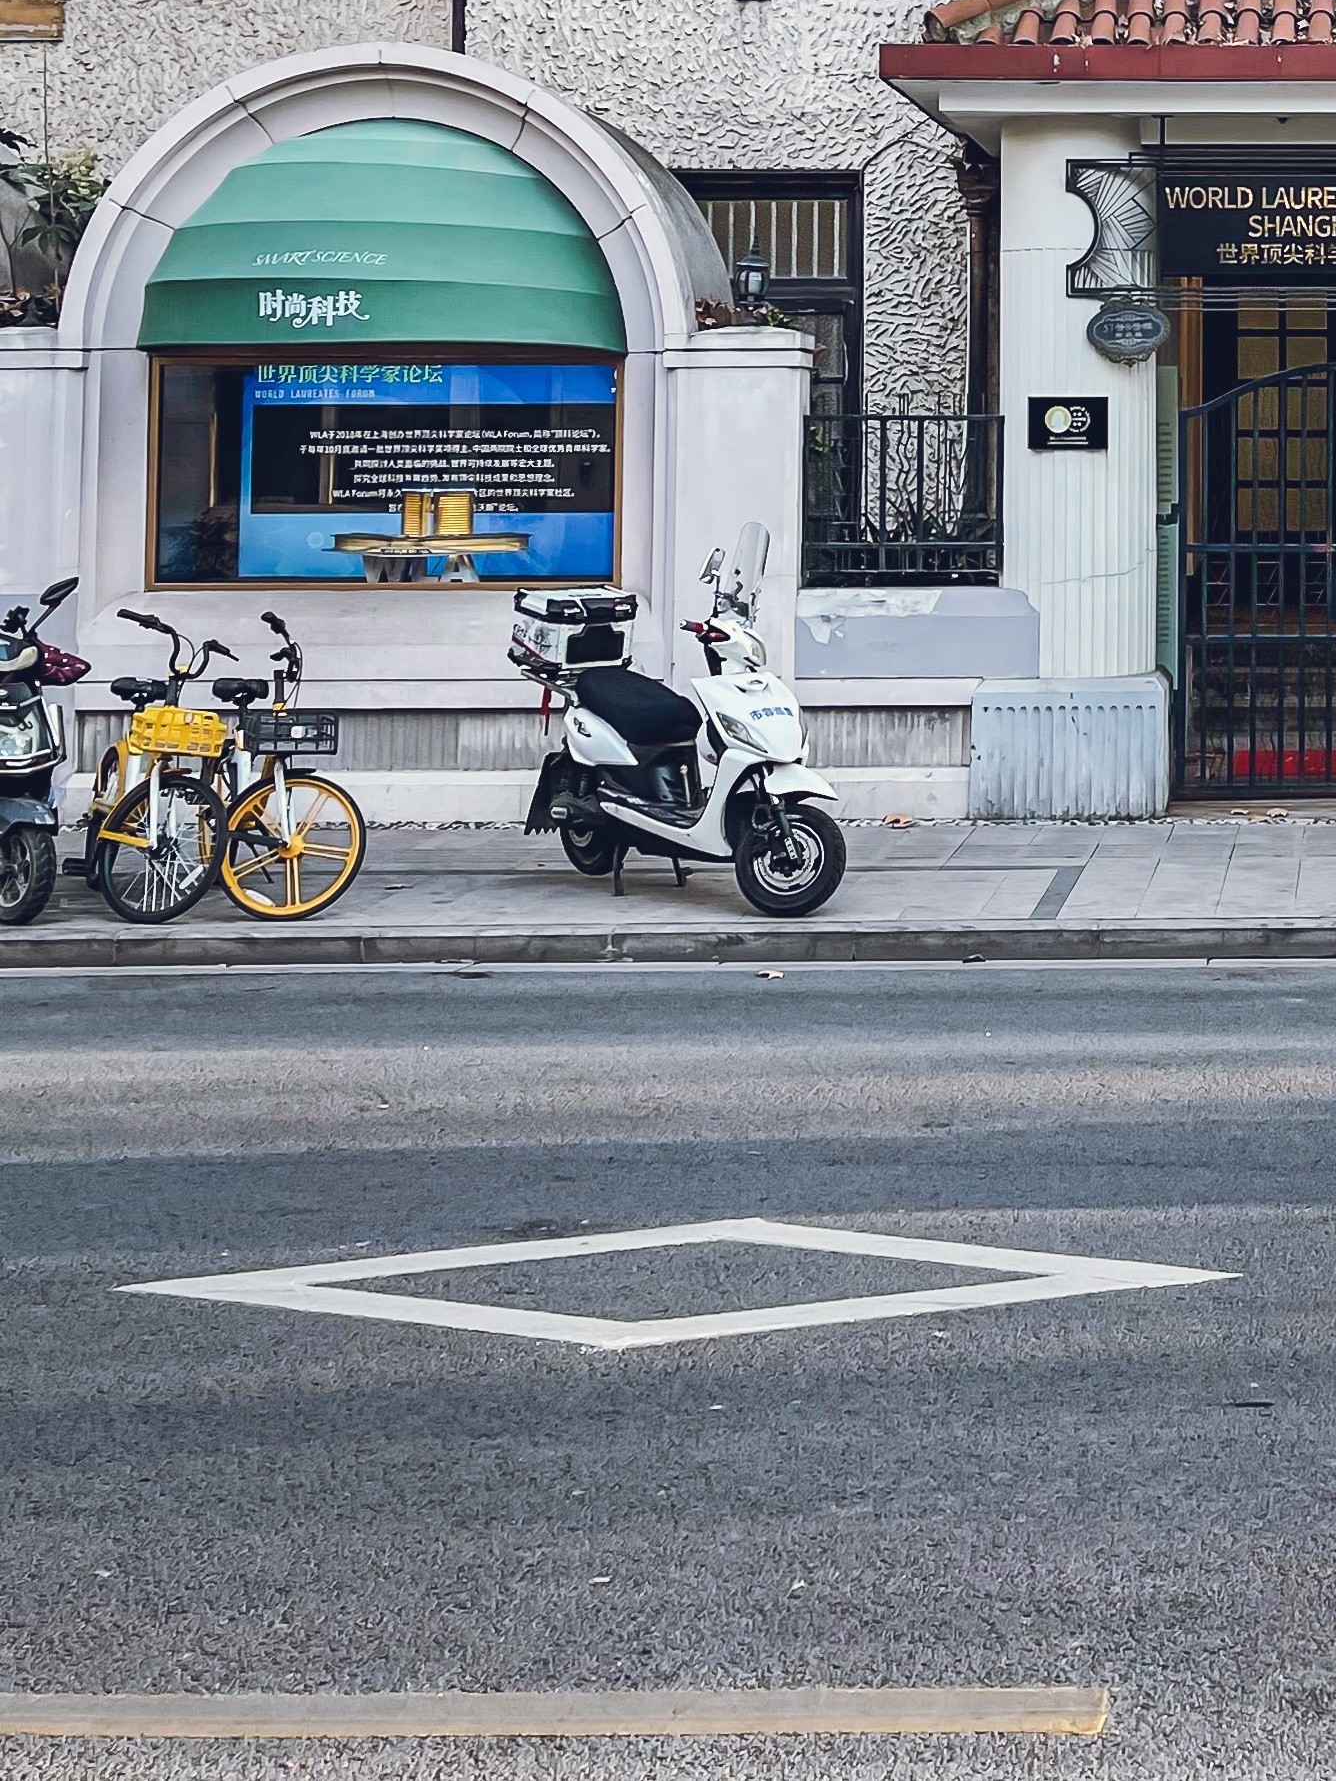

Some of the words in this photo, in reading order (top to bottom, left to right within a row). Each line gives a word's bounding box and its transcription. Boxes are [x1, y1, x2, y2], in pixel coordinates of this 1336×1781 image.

[1165, 186, 1254, 209] WORLD
[251, 250, 316, 266] SMART
[311, 251, 388, 265] SCIENCE
[259, 289, 370, 328] 时尚科技
[257, 365, 443, 383] 世界顶尖科学家论坛
